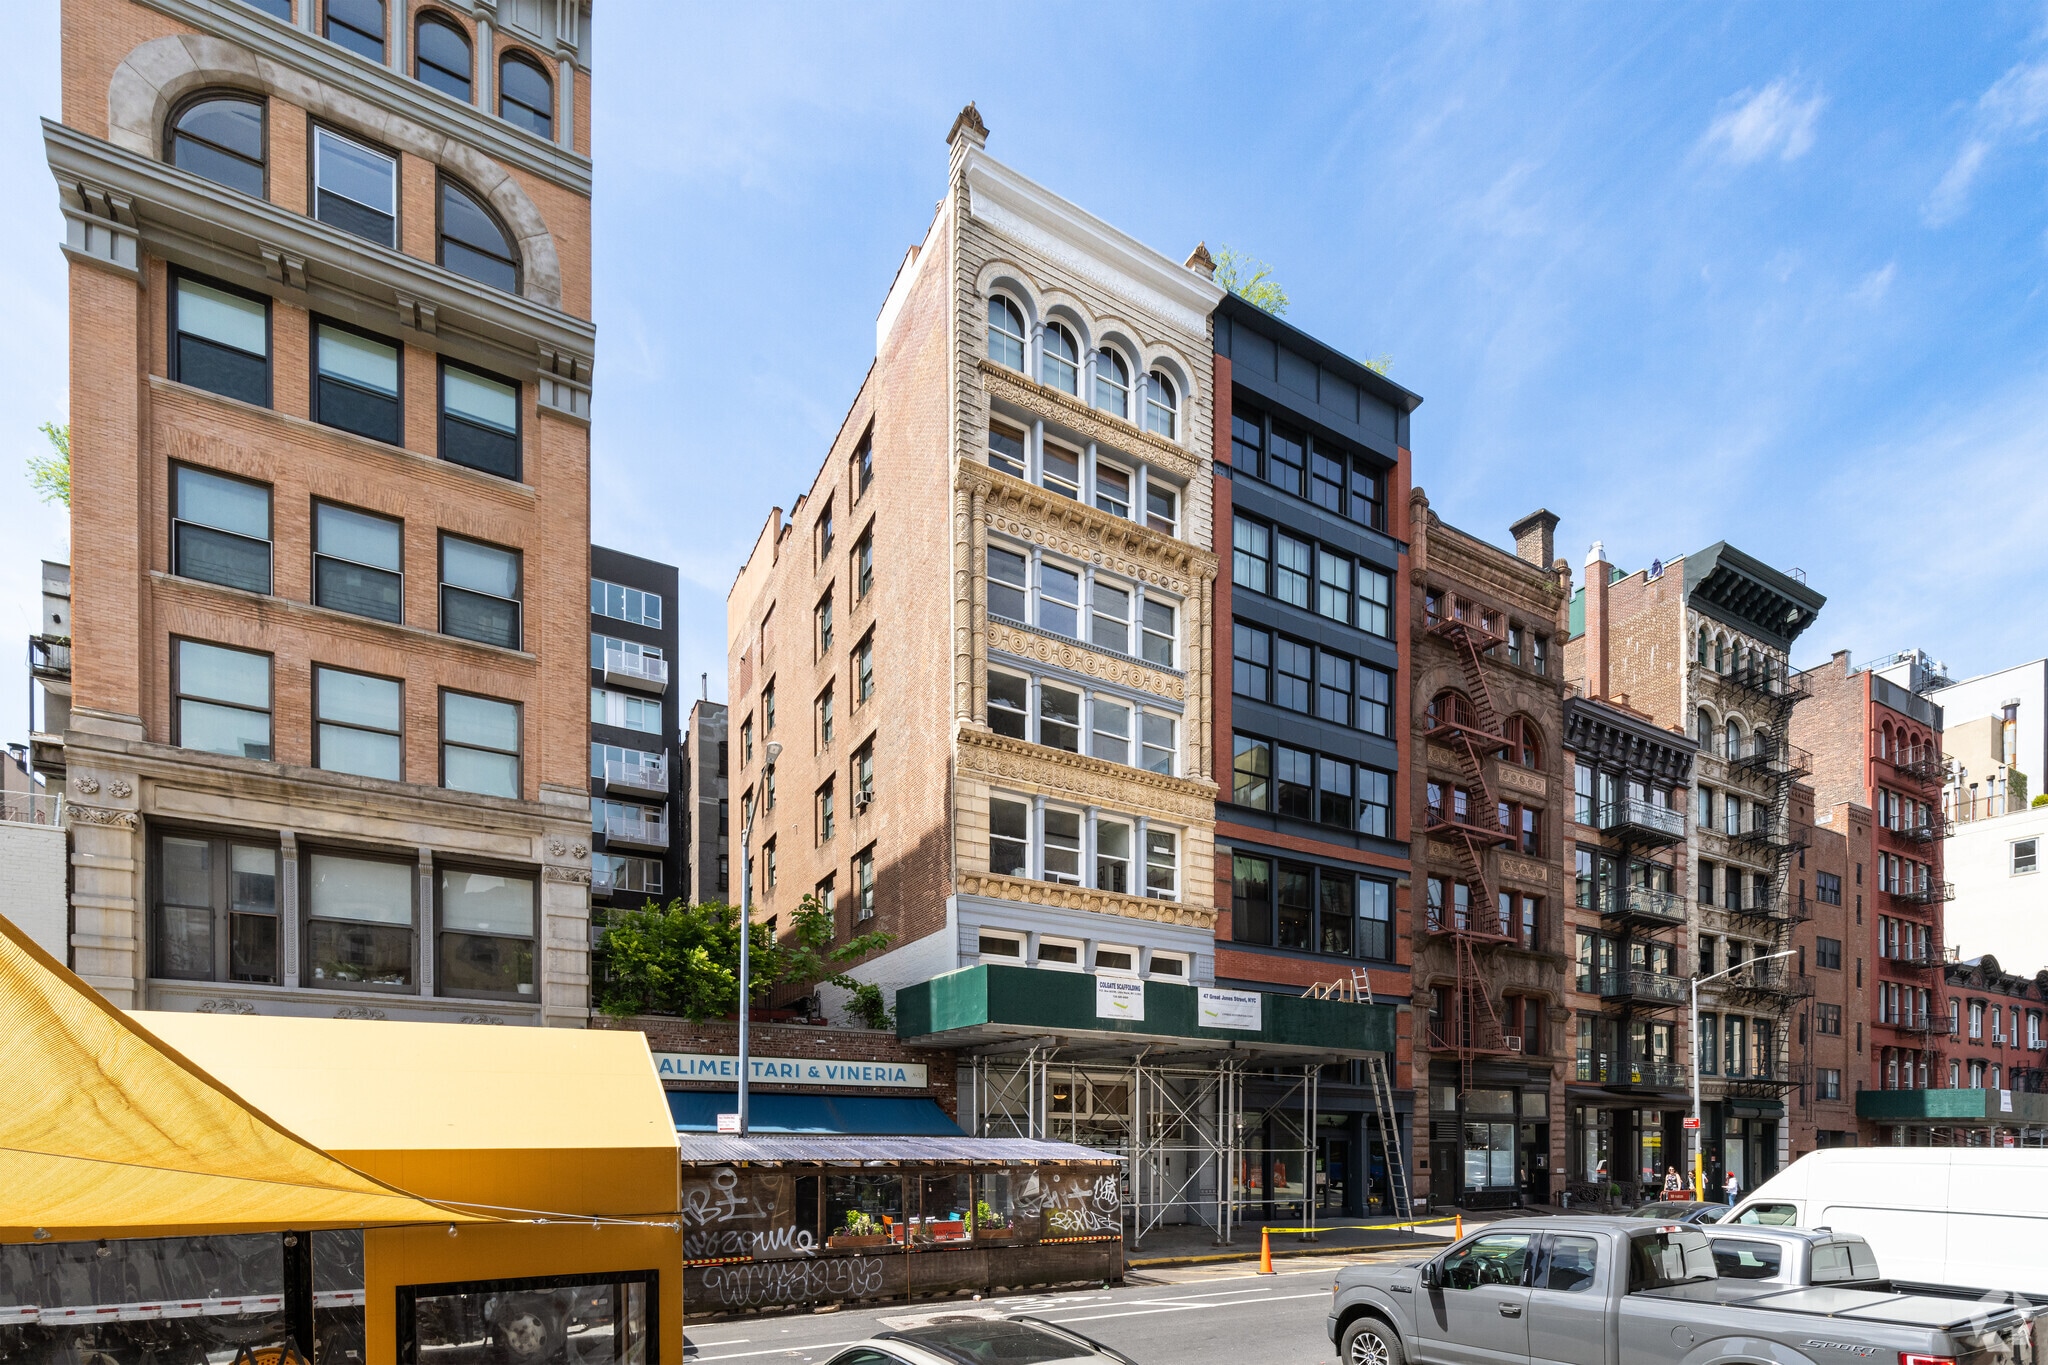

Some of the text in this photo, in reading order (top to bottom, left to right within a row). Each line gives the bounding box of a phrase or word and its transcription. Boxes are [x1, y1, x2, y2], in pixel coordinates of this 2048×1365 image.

[1099, 981, 1141, 992] COLGATE SCAFFOLDING
[1209, 993, 1220, 1001] Great
[808, 1065, 820, 1078] &
[826, 1065, 906, 1082] VINERIA
[1800, 1339, 1885, 1354] SPORT
